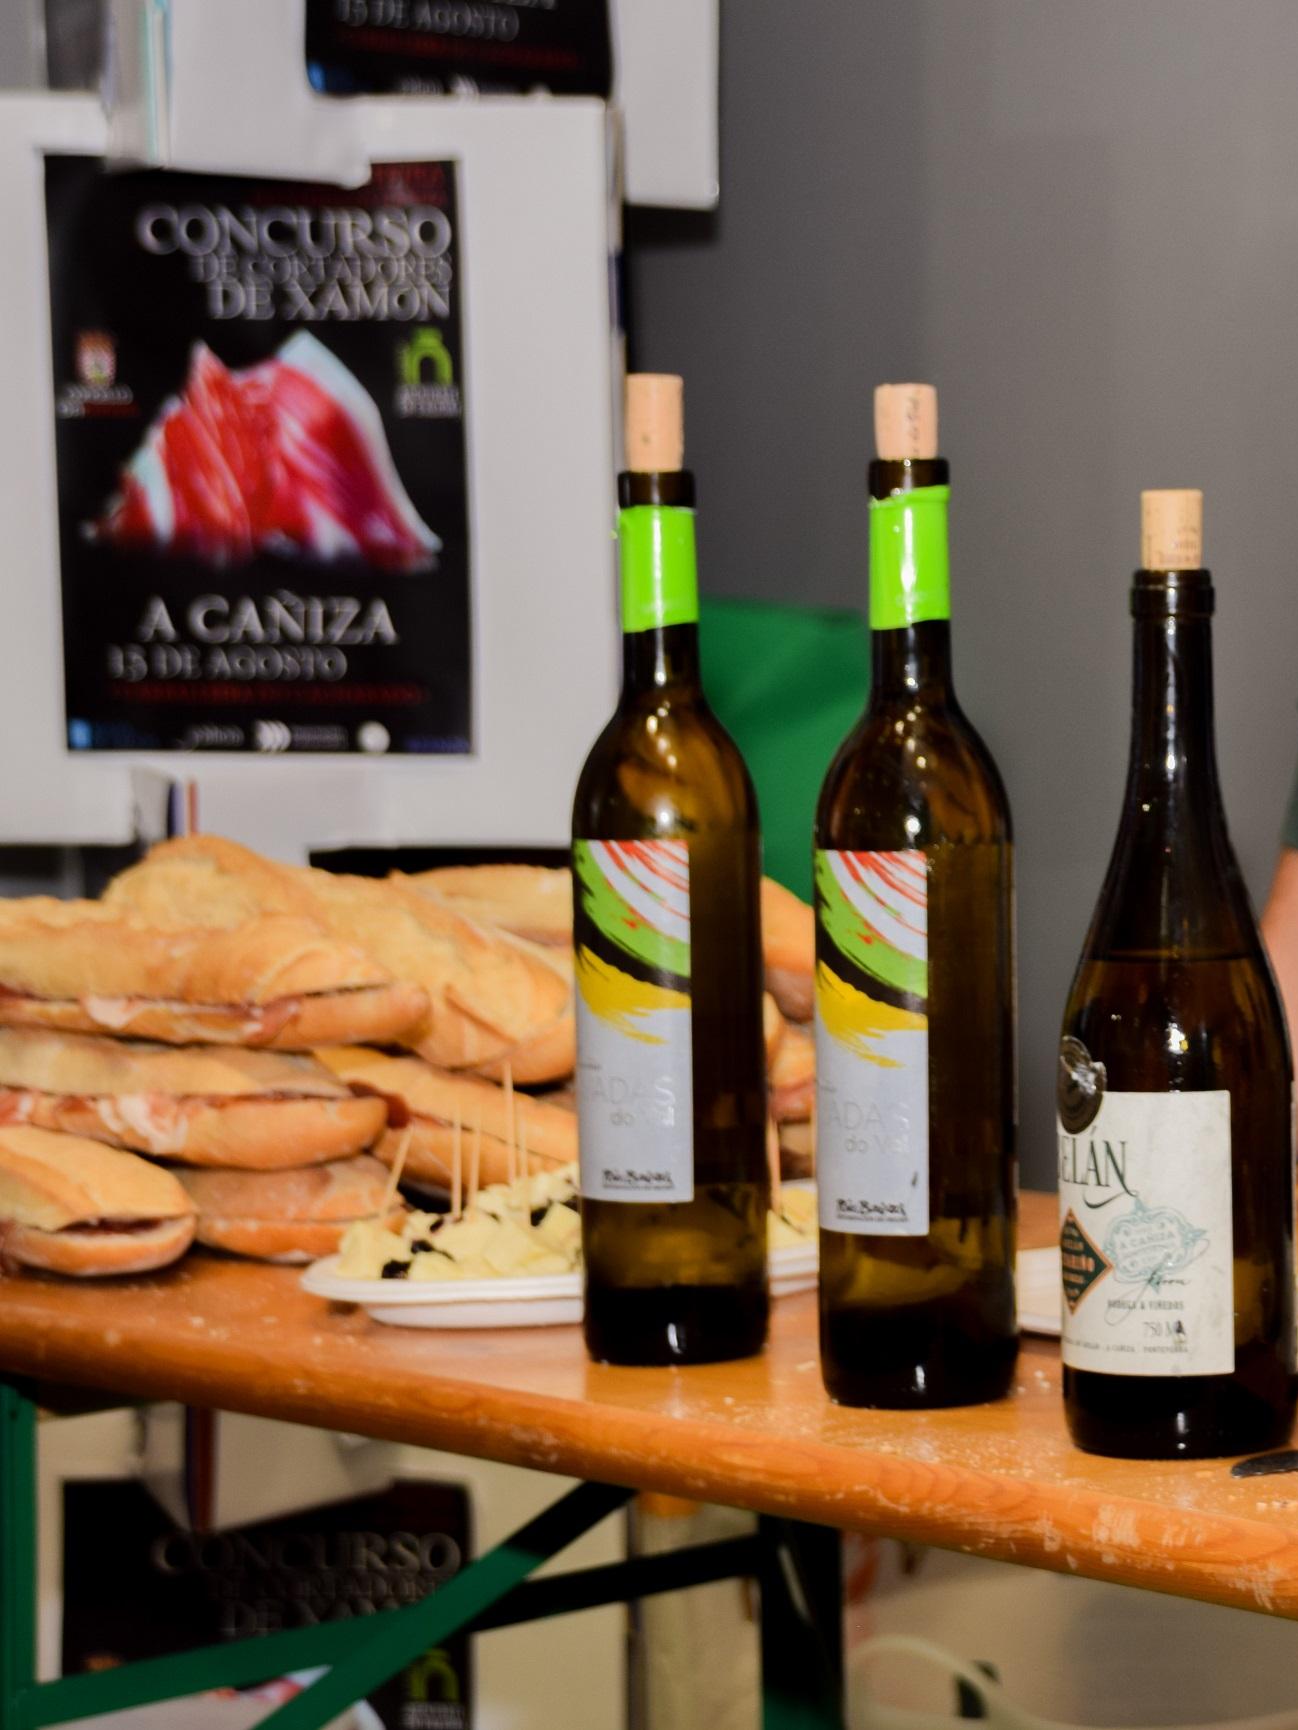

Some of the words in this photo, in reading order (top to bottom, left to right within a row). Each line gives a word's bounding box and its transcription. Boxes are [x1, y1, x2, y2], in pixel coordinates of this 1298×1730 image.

[137, 206, 452, 254] CONCURSO
[207, 278, 275, 321] DE
[138, 596, 180, 643] A
[187, 590, 399, 645] CAÑIZA
[152, 644, 201, 680] DE
[205, 645, 348, 682] AGOSTO
